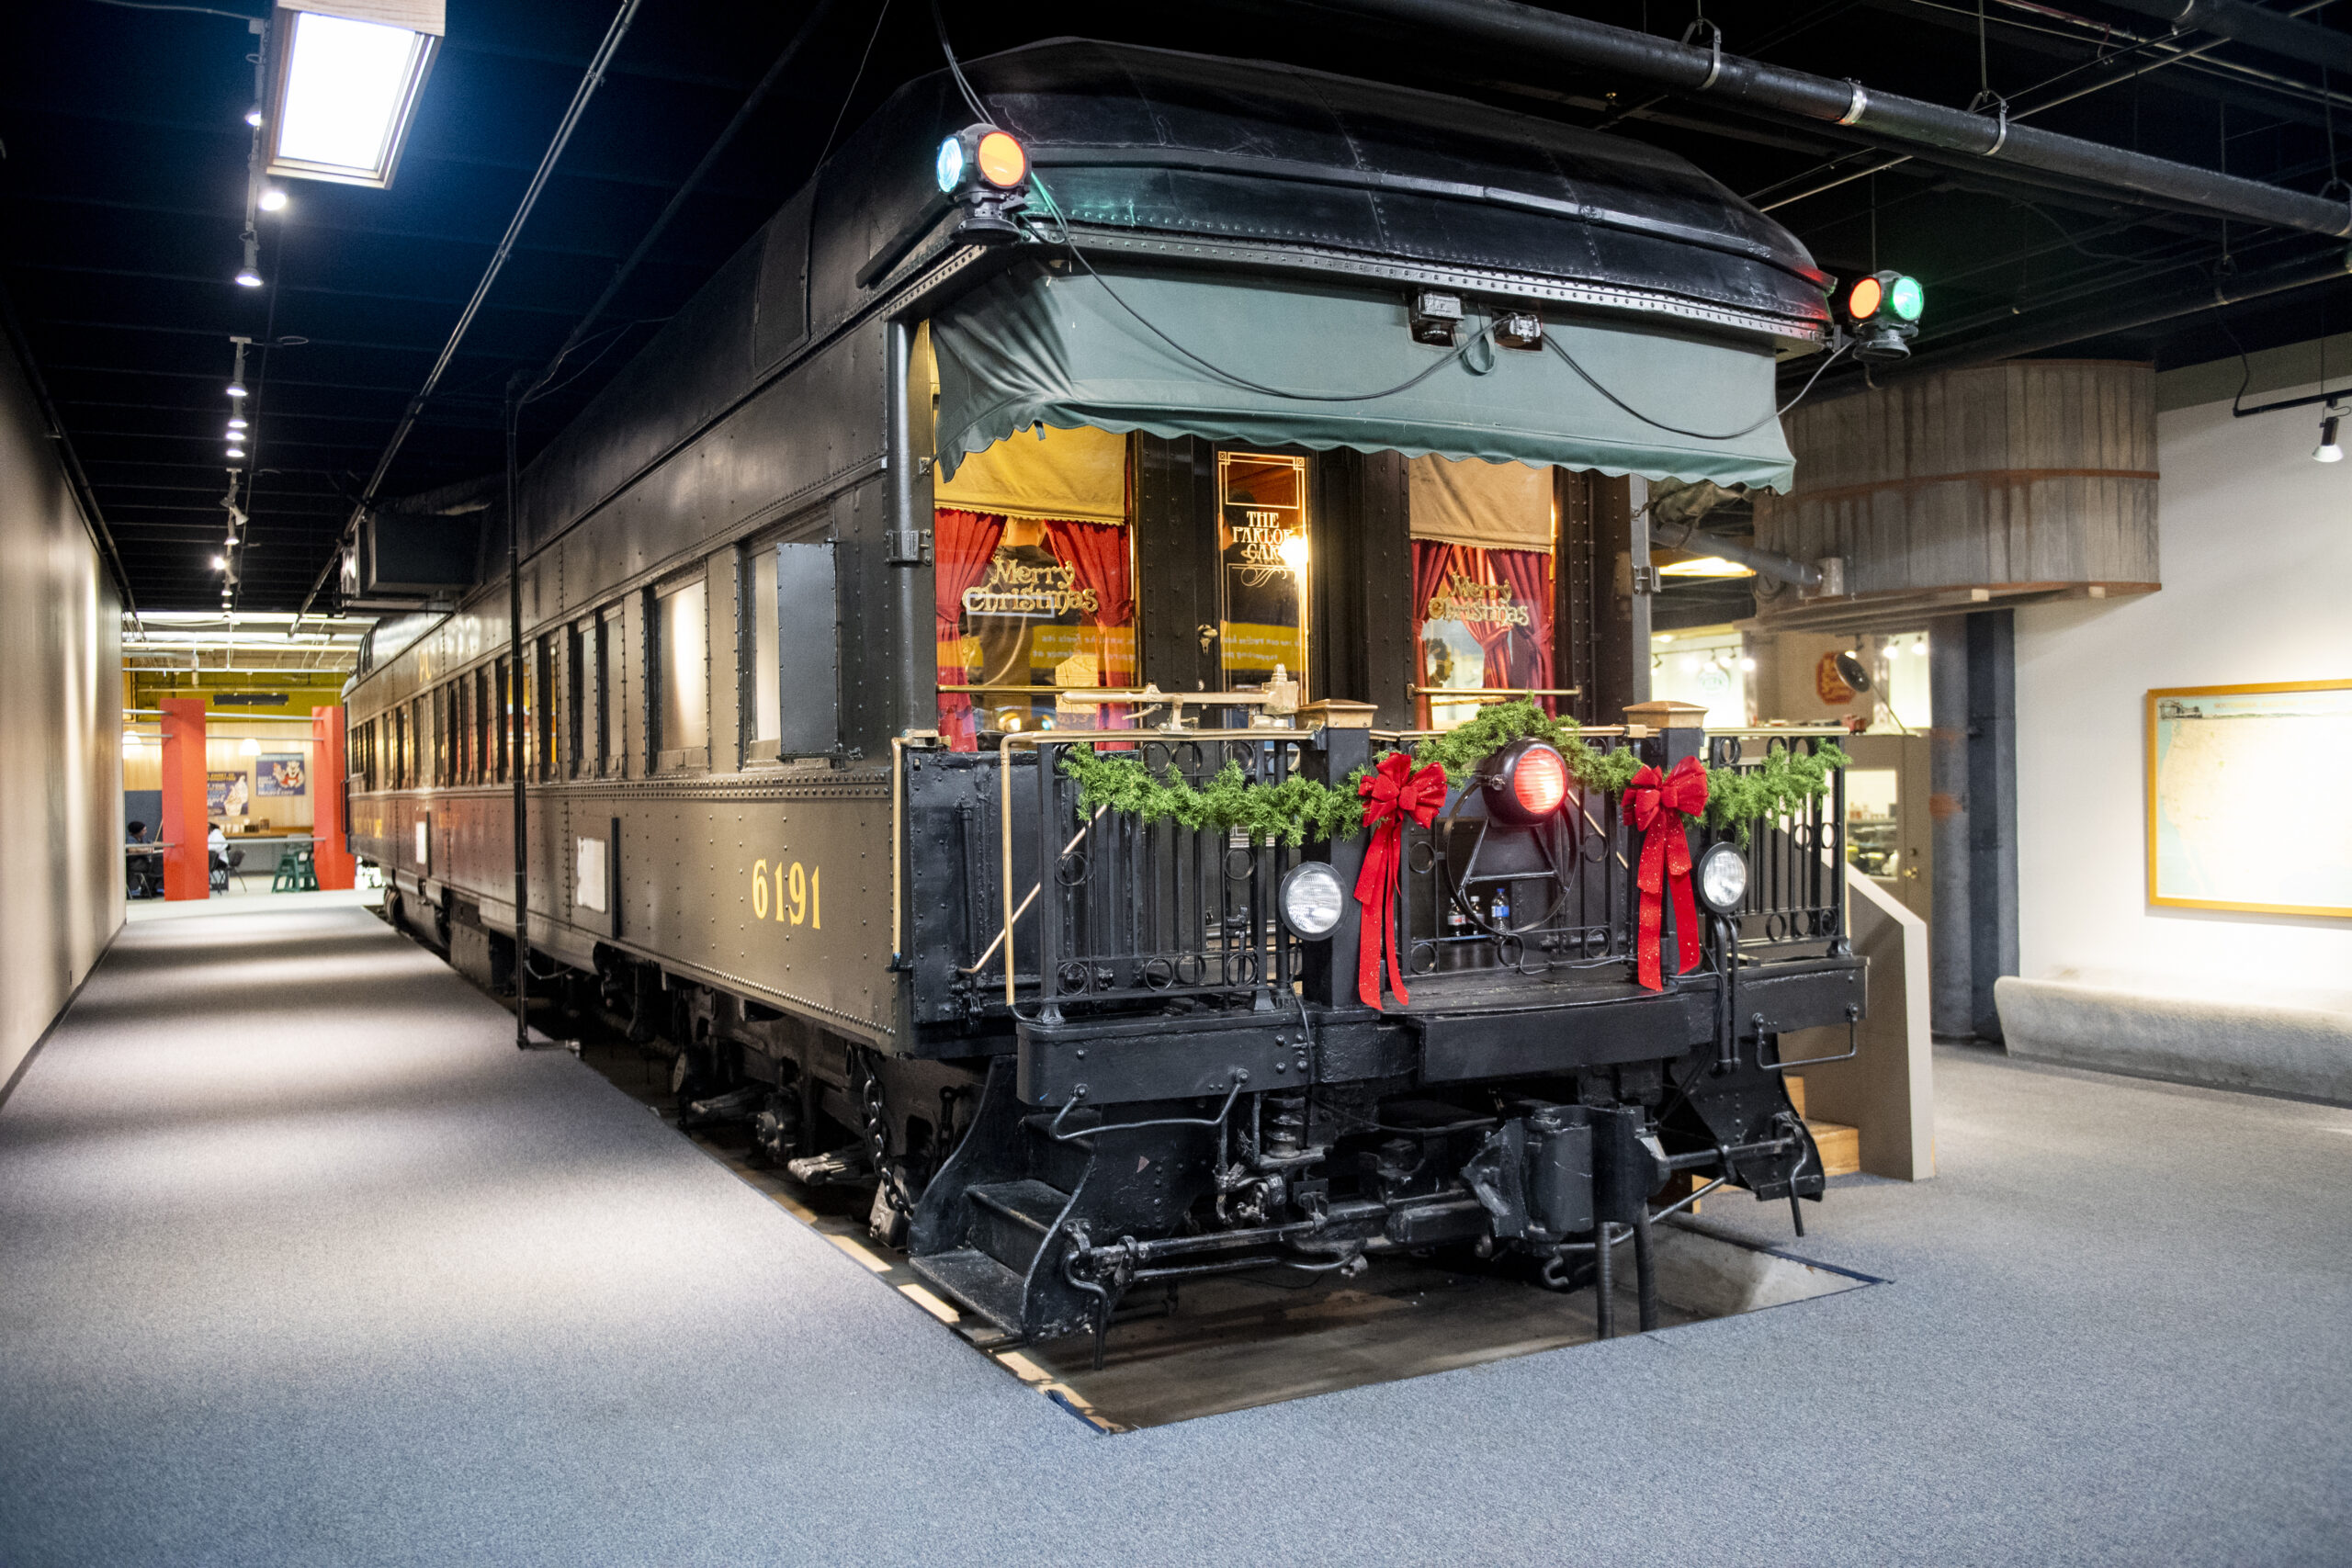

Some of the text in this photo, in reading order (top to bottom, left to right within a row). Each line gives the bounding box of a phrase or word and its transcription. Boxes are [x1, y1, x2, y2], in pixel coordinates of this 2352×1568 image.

[1246, 511, 1280, 528] THE
[1247, 543, 1281, 561] CAR
[989, 555, 1076, 590] Merry
[1449, 571, 1512, 604] Merry
[961, 582, 1099, 616] Christmas
[1428, 597, 1530, 626] Christmas
[752, 858, 821, 930] 6191
